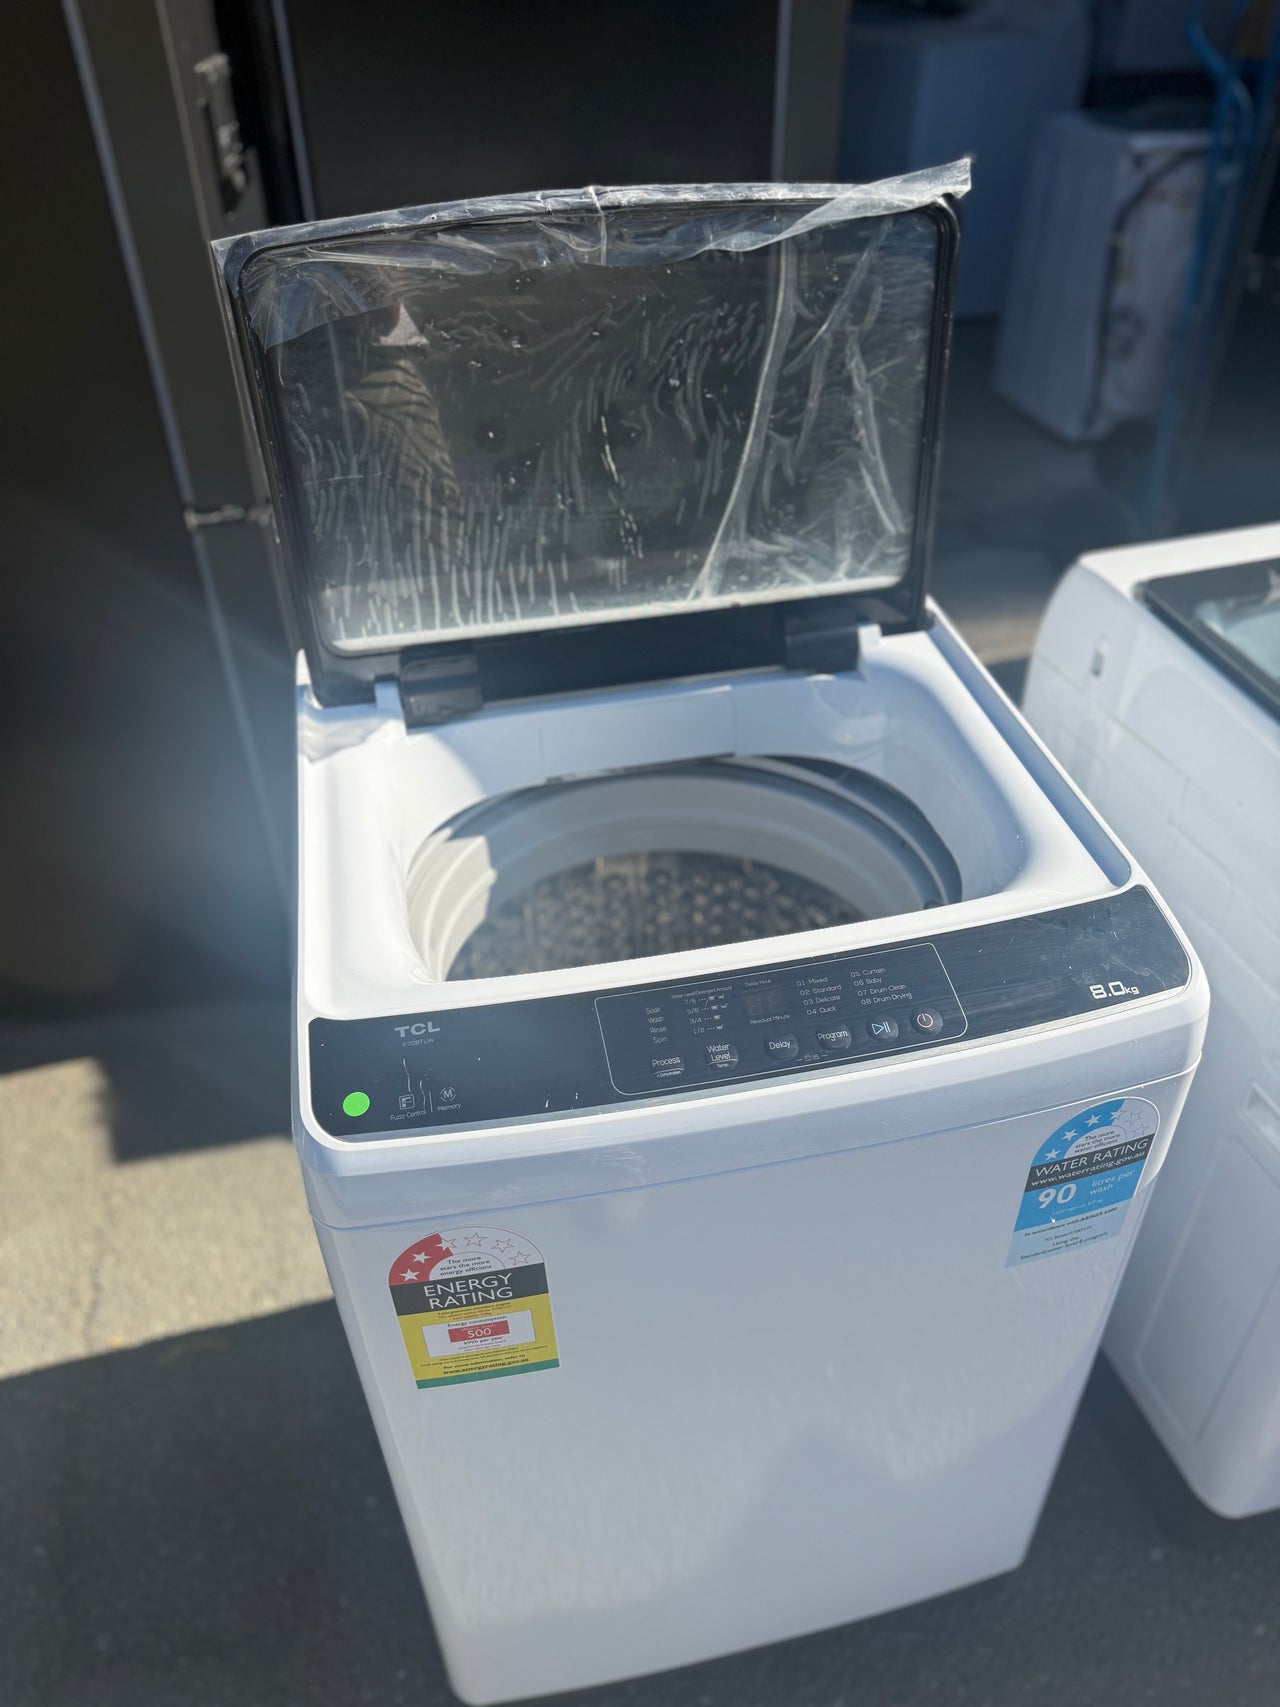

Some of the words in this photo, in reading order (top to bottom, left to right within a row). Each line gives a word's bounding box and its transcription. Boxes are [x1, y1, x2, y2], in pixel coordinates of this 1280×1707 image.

[862, 968, 886, 976] Curtain
[812, 984, 842, 994] Standard
[815, 995, 840, 1004] Delicate
[892, 992, 913, 1000] Drying
[818, 1006, 837, 1014] Quick
[394, 1022, 440, 1037] TCL
[653, 1036, 668, 1044] Spin
[817, 1030, 848, 1041] Program
[706, 1044, 730, 1053] Water
[768, 1041, 791, 1050] Delay
[710, 1052, 731, 1061] Level
[652, 1057, 680, 1068] Process
[438, 1103, 461, 1112] Memory
[406, 1110, 426, 1118] Control
[1035, 1157, 1087, 1177] WATER
[1093, 1139, 1149, 1164] RATING
[1031, 1151, 1145, 1186] www.waterrating.gov.au
[1091, 1176, 1115, 1187] litres
[1118, 1170, 1135, 1181] per
[1089, 1184, 1113, 1195] wash
[1038, 1183, 1077, 1210] 90
[423, 1272, 512, 1297] ENERGY
[428, 1287, 513, 1310] RATING
[469, 1315, 507, 1324] consumption
[468, 1328, 492, 1338] 500
